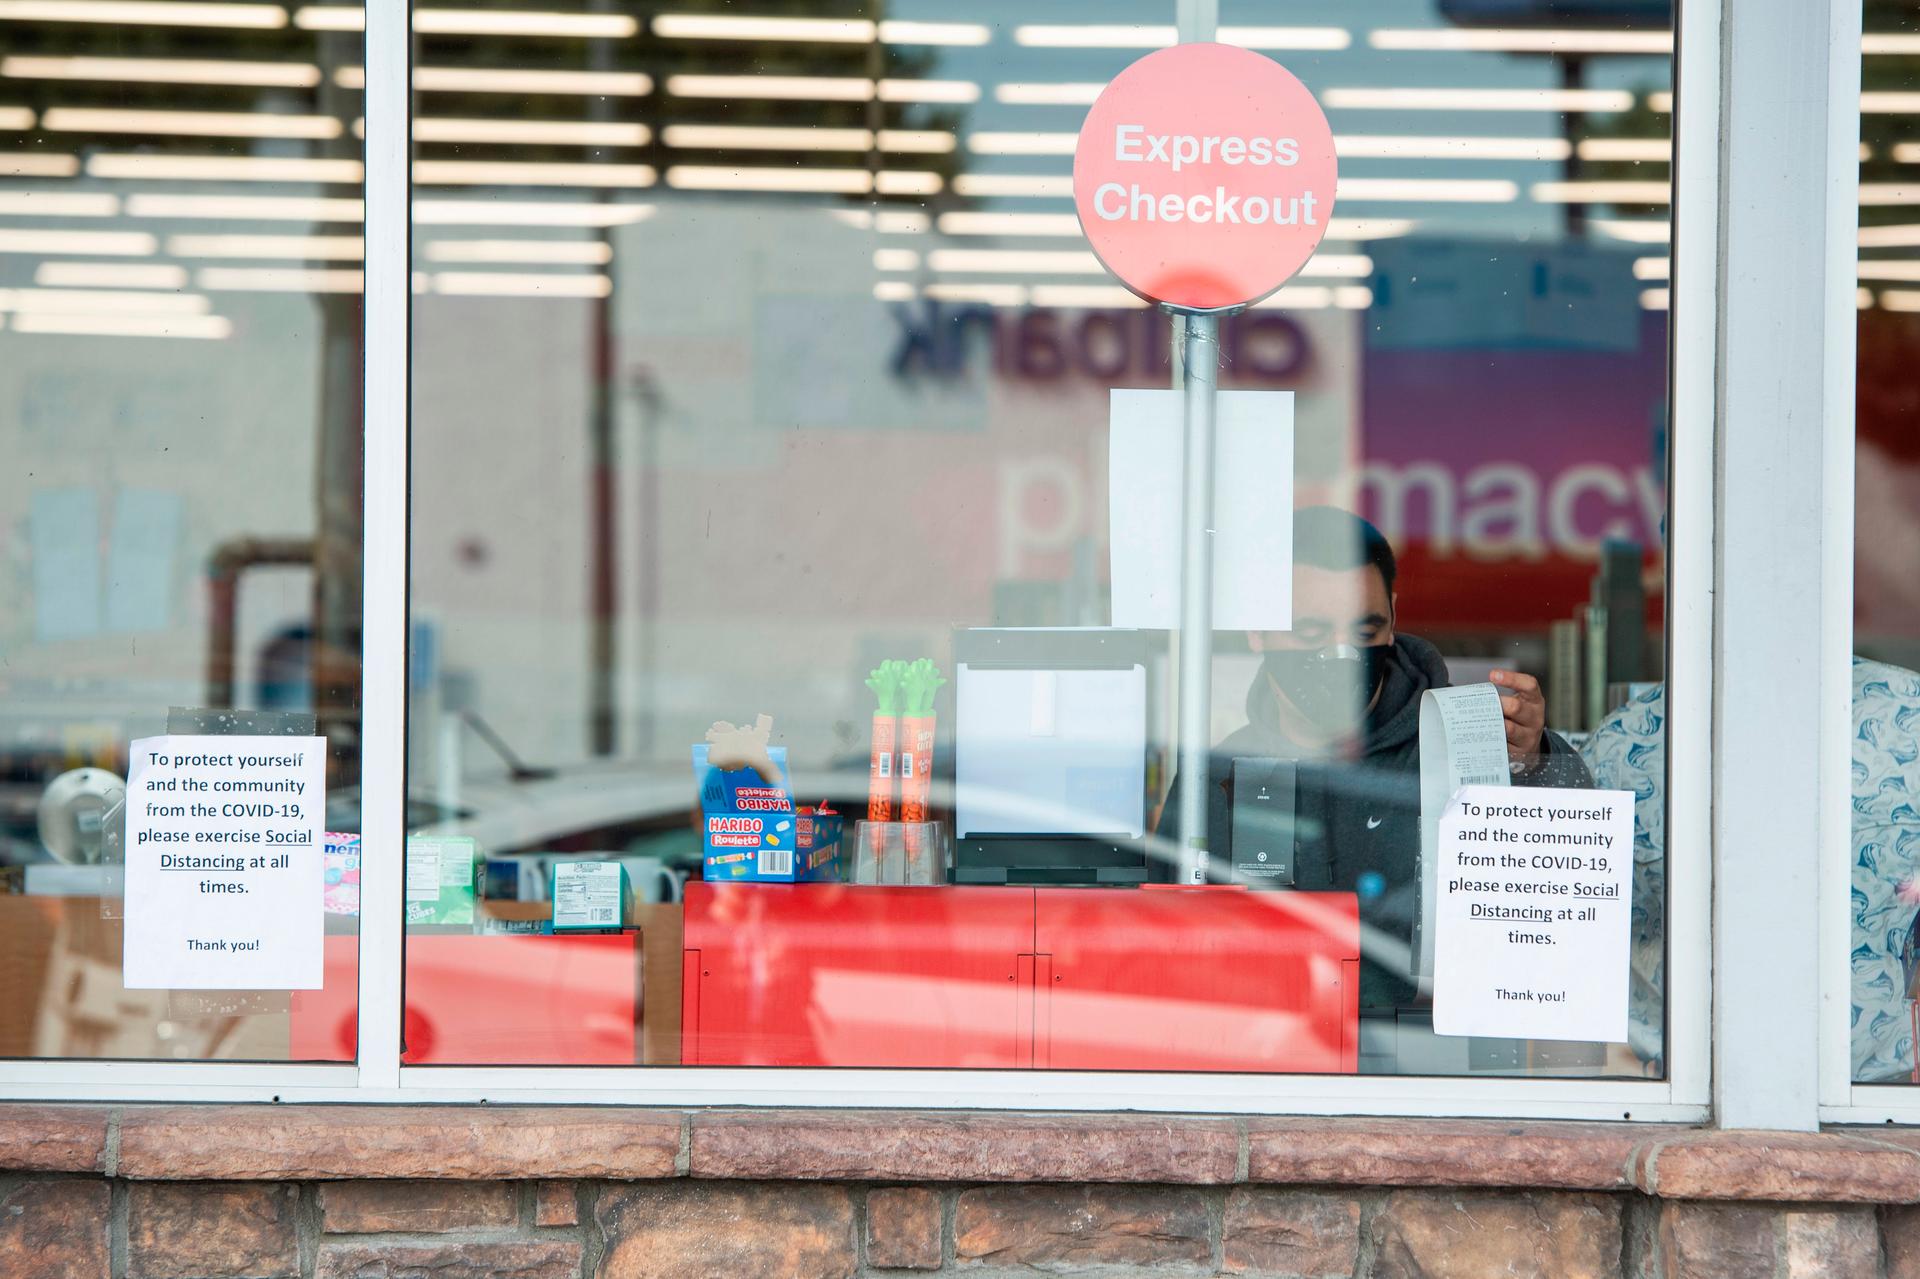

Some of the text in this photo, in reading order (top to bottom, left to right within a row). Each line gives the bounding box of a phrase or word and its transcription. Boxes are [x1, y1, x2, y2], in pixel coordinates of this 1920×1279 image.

[1115, 124, 1300, 172] Express
[1093, 182, 1318, 225] Checkout
[148, 752, 304, 770] To protect yourself
[146, 777, 305, 796] and the community
[146, 802, 305, 820] from the COVID-19,
[736, 799, 791, 811] HARIBO
[1461, 802, 1613, 823] To protect yourself
[708, 817, 763, 832] HARIBO
[138, 827, 313, 846] please exercise Social
[713, 835, 759, 847] Roulette
[1458, 827, 1614, 849] and the community
[159, 854, 289, 872] Distancing at all
[1457, 851, 1612, 874] from the COVID-19,
[199, 879, 249, 894] times.
[1449, 876, 1619, 898] please exercise Social
[1471, 903, 1596, 923] Distancing at all
[187, 939, 259, 953] Thank you!
[1507, 930, 1556, 945] times.
[1495, 988, 1566, 1004] Thank you!
